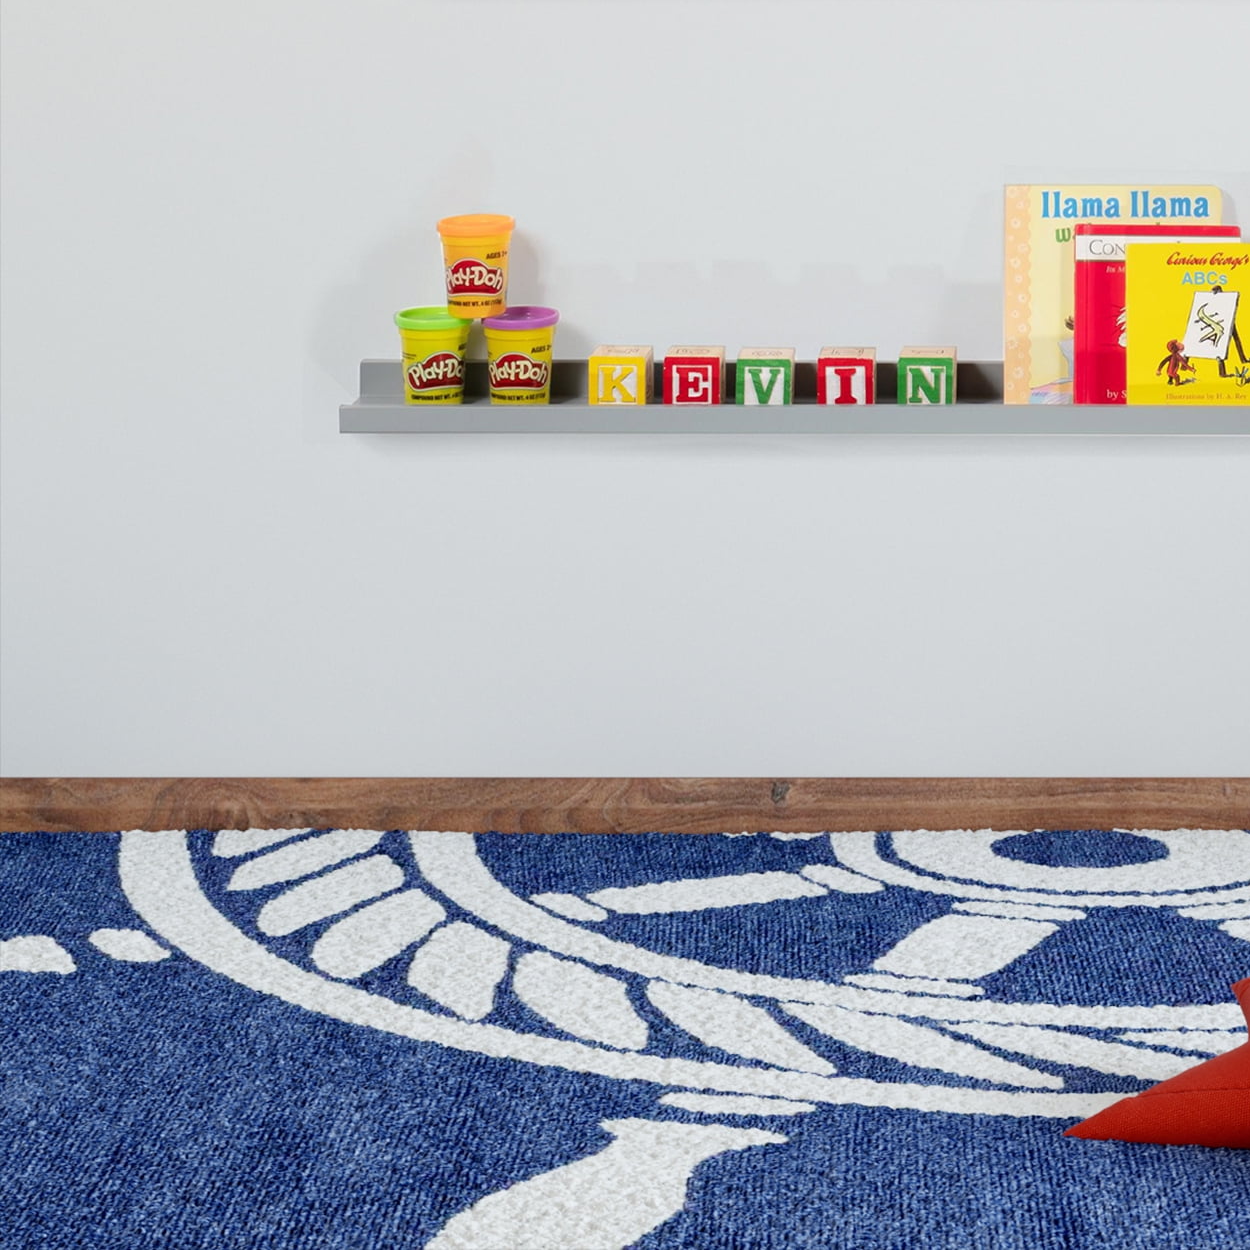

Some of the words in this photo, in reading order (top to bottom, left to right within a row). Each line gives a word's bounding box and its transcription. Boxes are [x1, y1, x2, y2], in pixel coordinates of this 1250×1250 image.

[1041, 190, 1122, 219] llama
[1130, 190, 1210, 219] llama
[1181, 271, 1228, 286] ABCs
[1107, 389, 1118, 399] by
